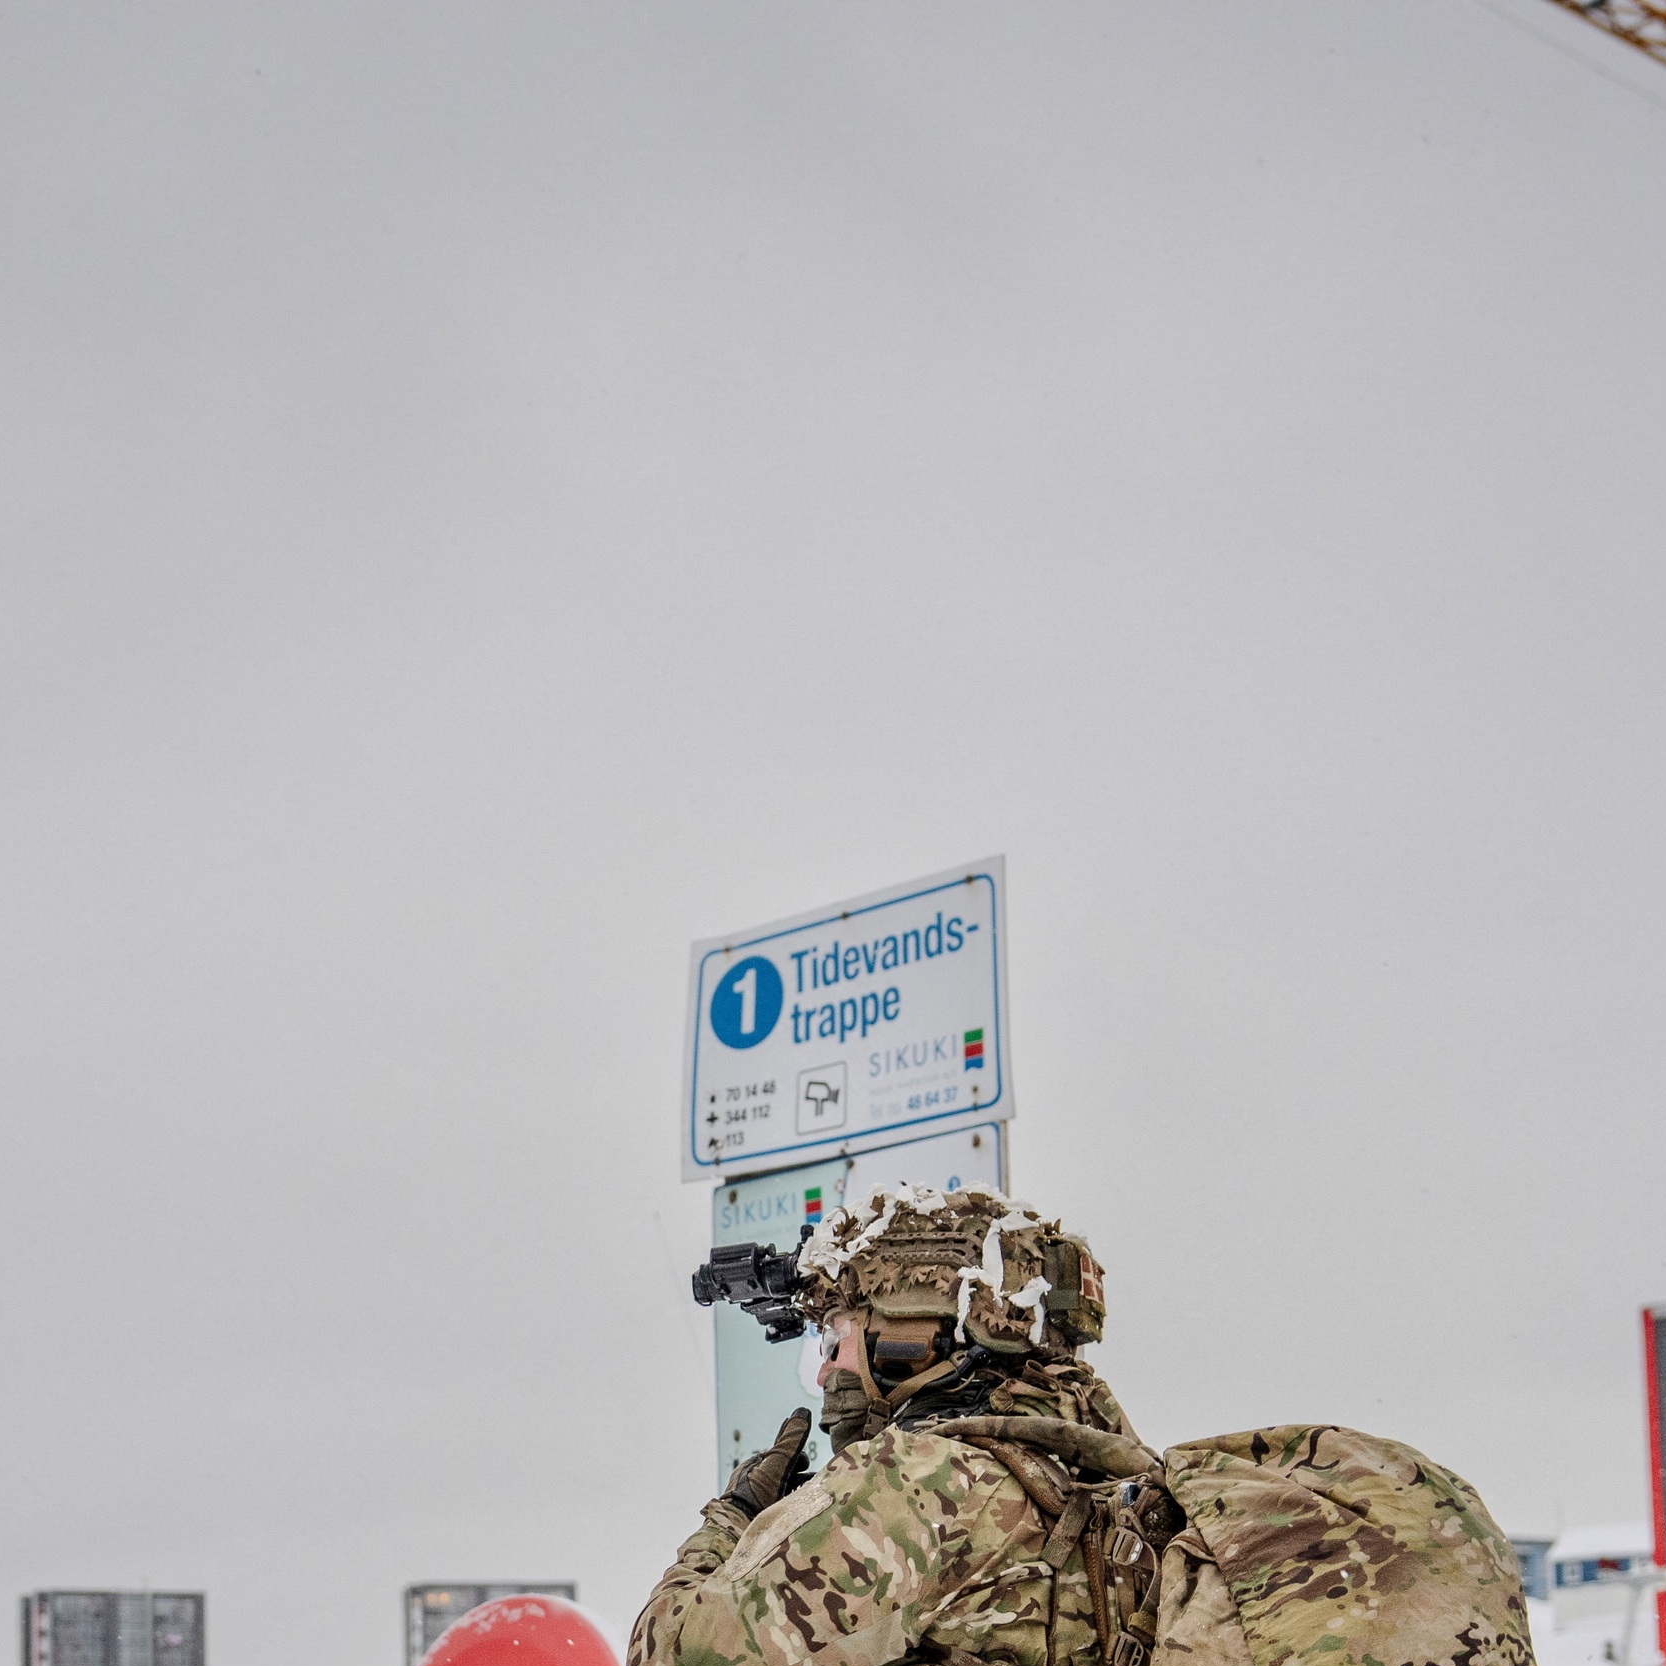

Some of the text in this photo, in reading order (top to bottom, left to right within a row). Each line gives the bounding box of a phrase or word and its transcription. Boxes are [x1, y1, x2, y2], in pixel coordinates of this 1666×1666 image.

[790, 911, 979, 993] Tidevands-
[732, 967, 757, 1036] 1
[791, 986, 900, 1044] trappe
[869, 1034, 957, 1077] SIKUKI
[721, 1192, 797, 1229] SIKUKI
